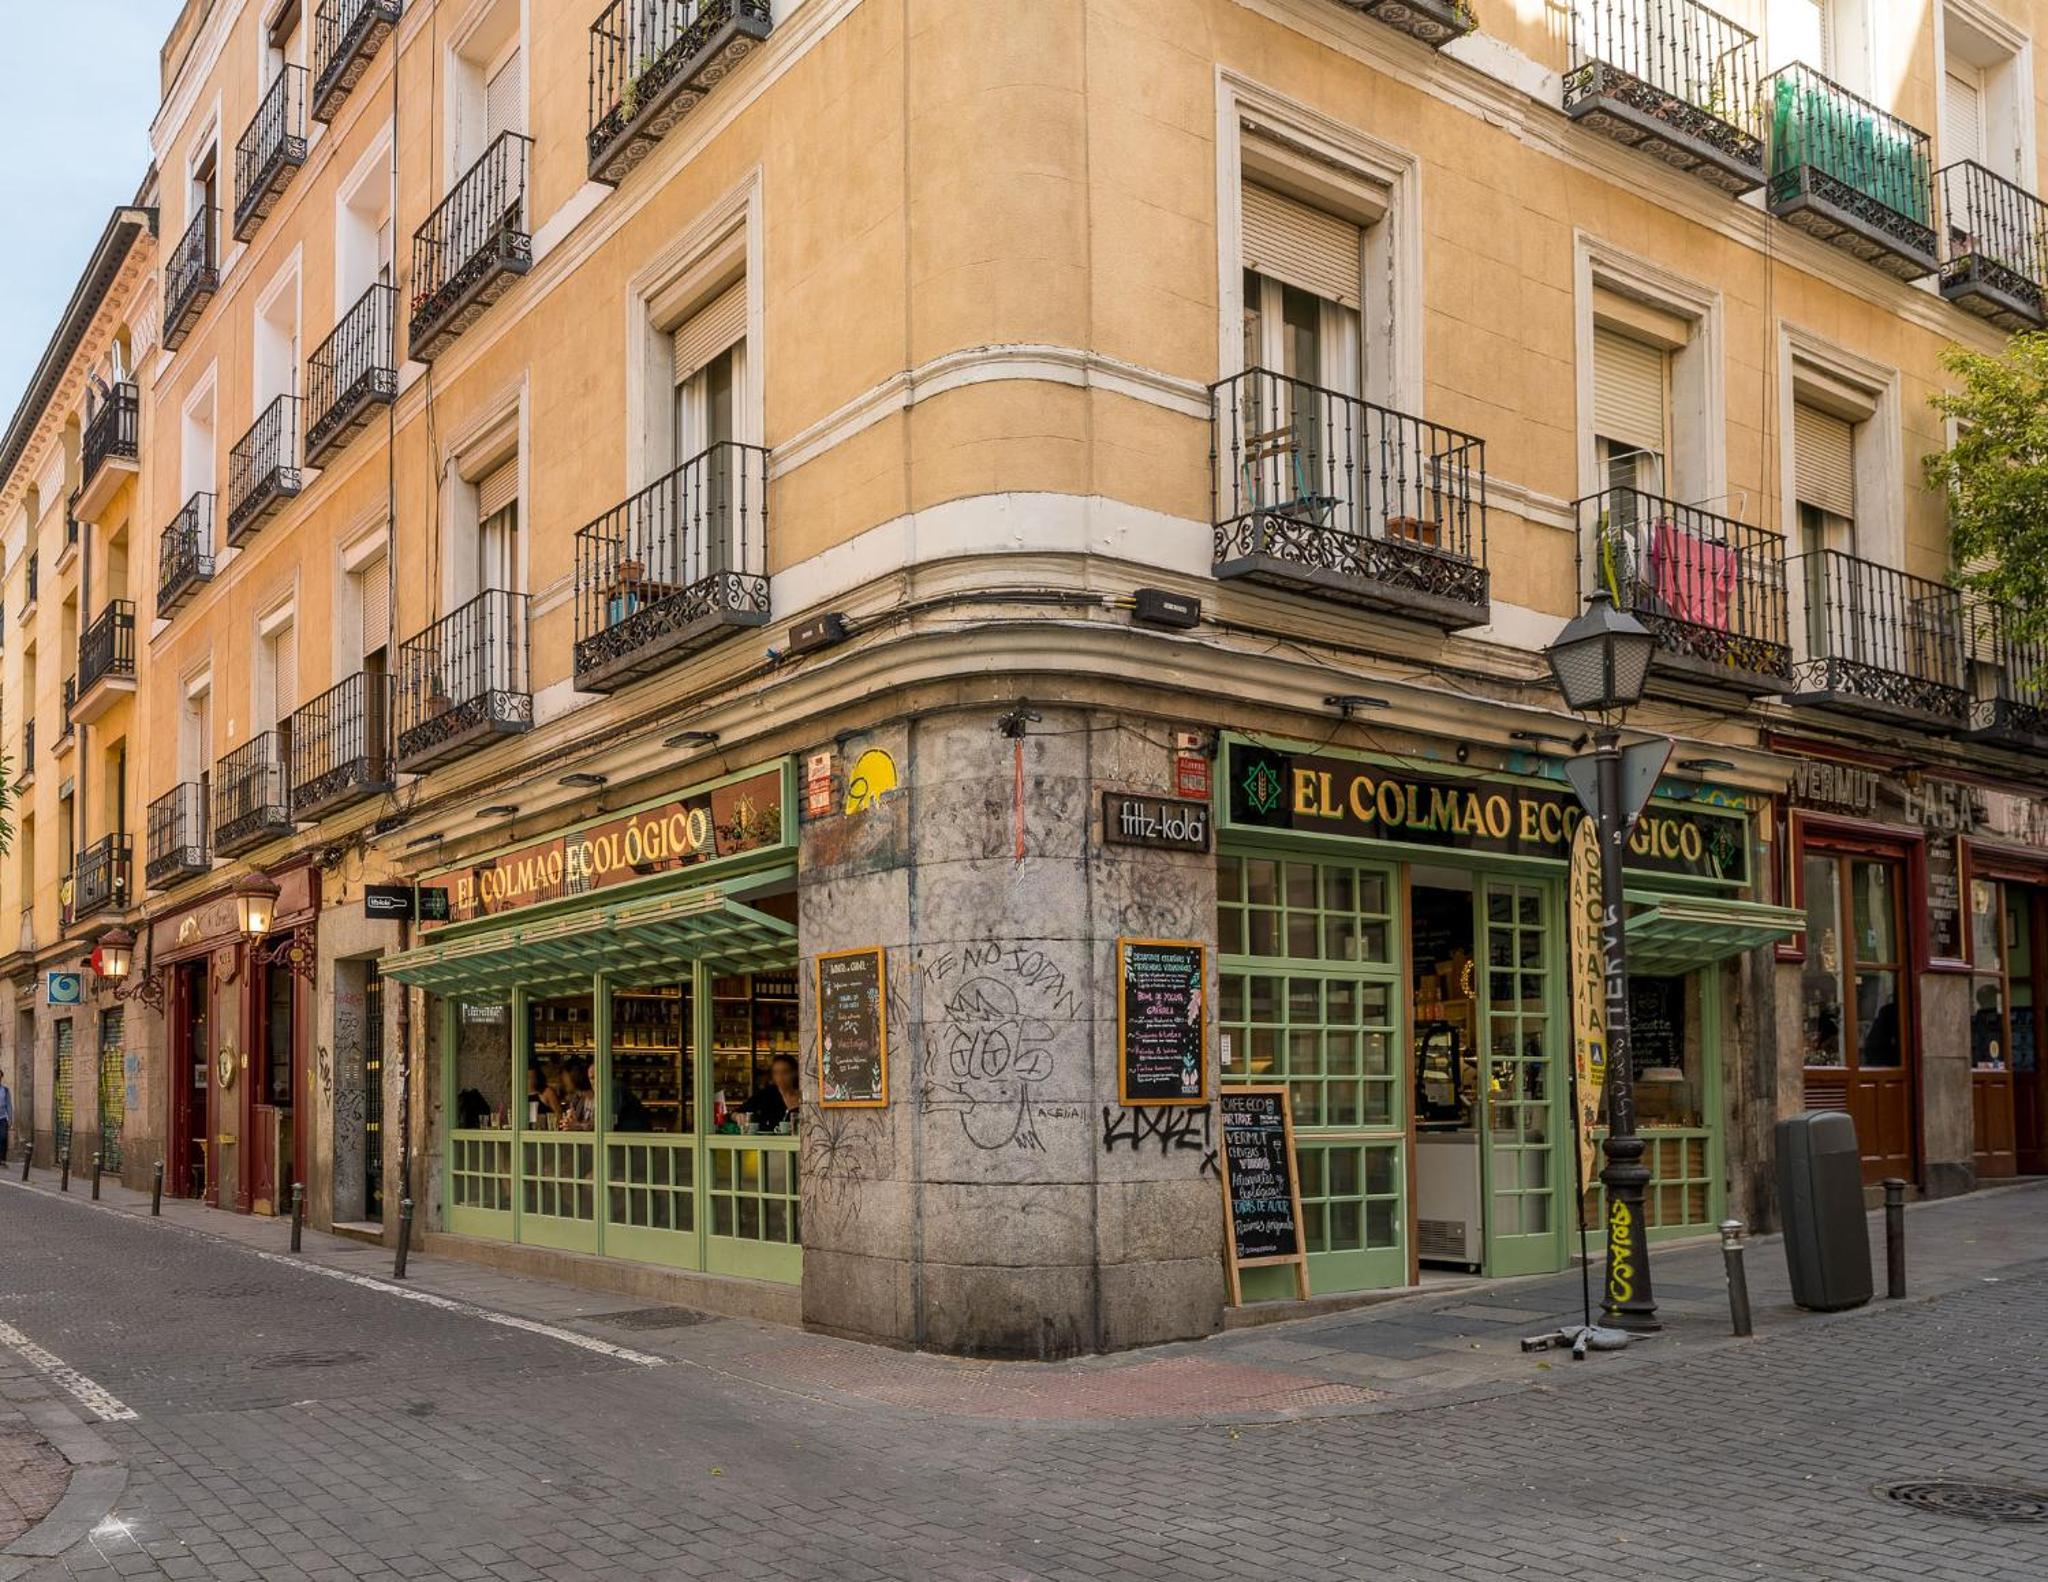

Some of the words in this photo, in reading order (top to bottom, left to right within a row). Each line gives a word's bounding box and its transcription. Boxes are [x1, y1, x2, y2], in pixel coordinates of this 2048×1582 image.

[1794, 762, 1879, 808] VERMUT
[1293, 768, 1343, 819] EL
[1350, 776, 1512, 839] COLMAO
[1519, 799, 1702, 860] ECOGICO
[457, 875, 479, 910] EL
[481, 850, 563, 903] COLMAO
[566, 807, 707, 882] ECOLÓGICO
[962, 942, 1001, 974] NO
[1225, 1131, 1267, 1145] VERMUT
